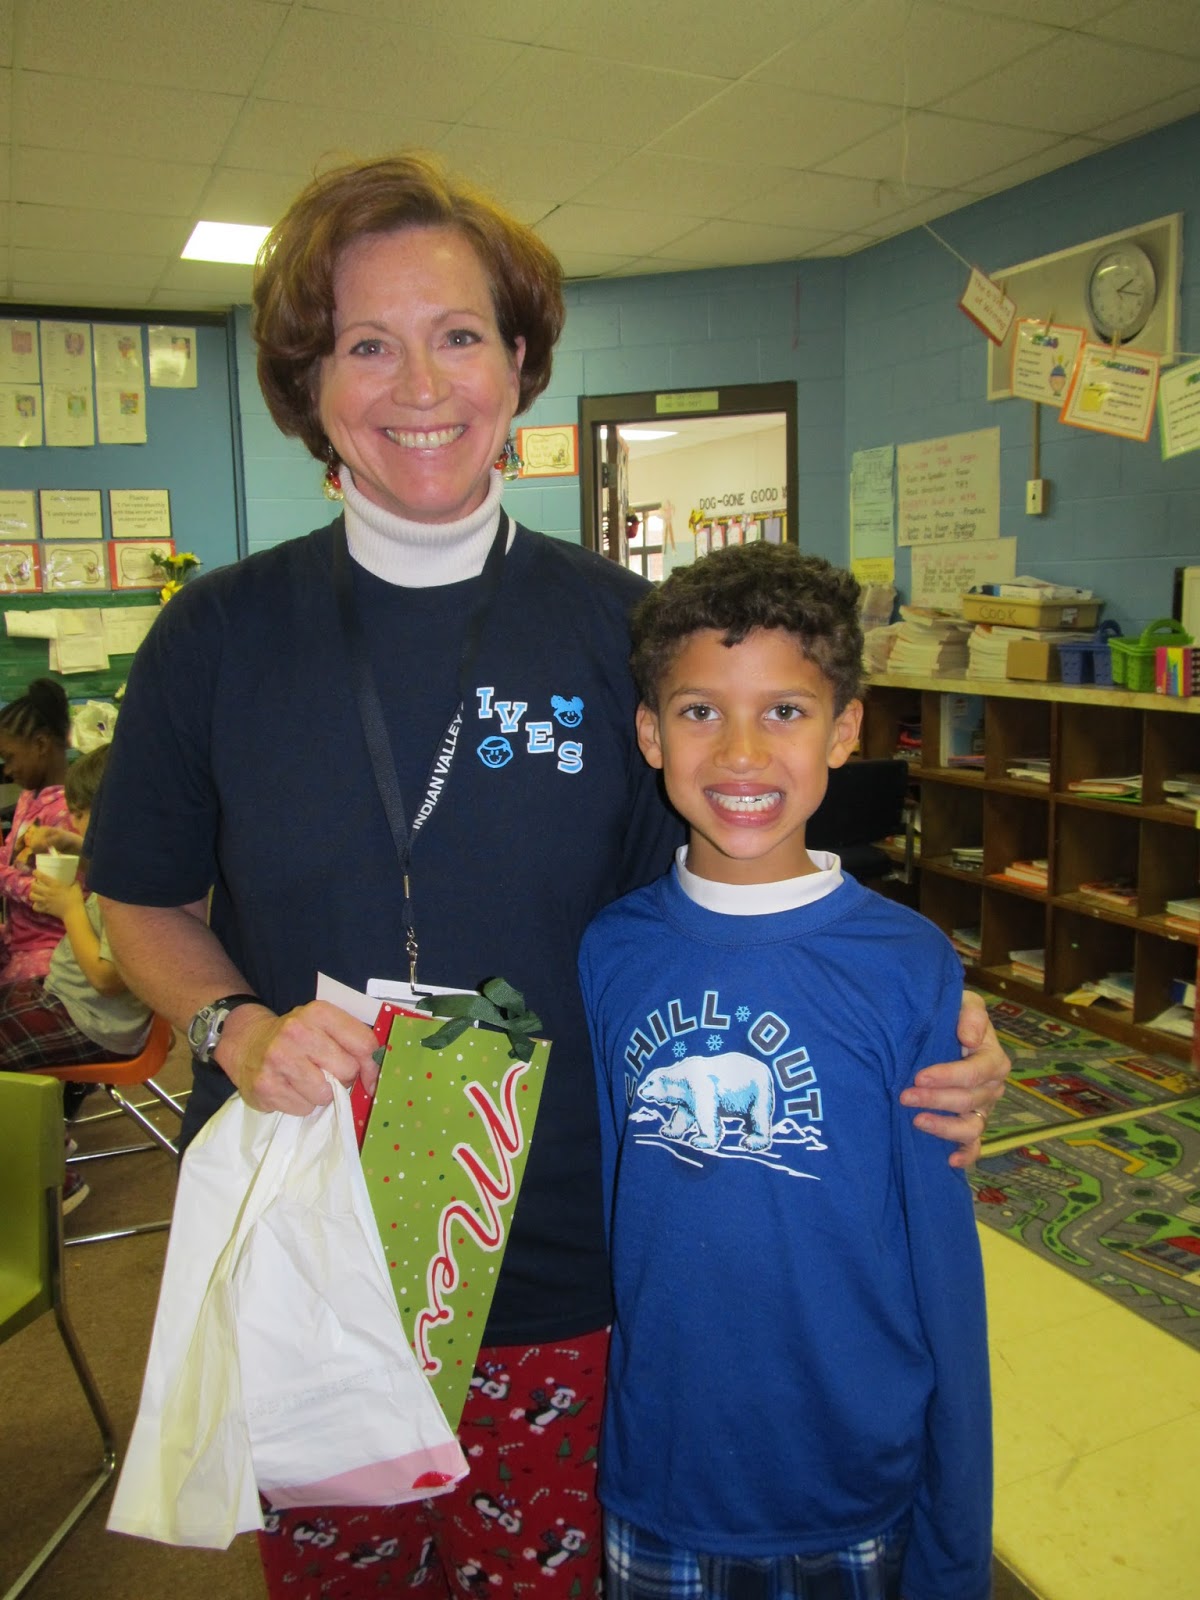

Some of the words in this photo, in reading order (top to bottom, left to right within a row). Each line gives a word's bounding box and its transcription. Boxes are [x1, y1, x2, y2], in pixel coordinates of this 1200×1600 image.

[700, 493, 745, 510] DOG-GONE
[751, 487, 778, 503] GOOD
[412, 776, 445, 830] INDIAN
[434, 713, 463, 774] VALLEY
[476, 686, 584, 774] IVES
[747, 1011, 824, 1121] OUT
